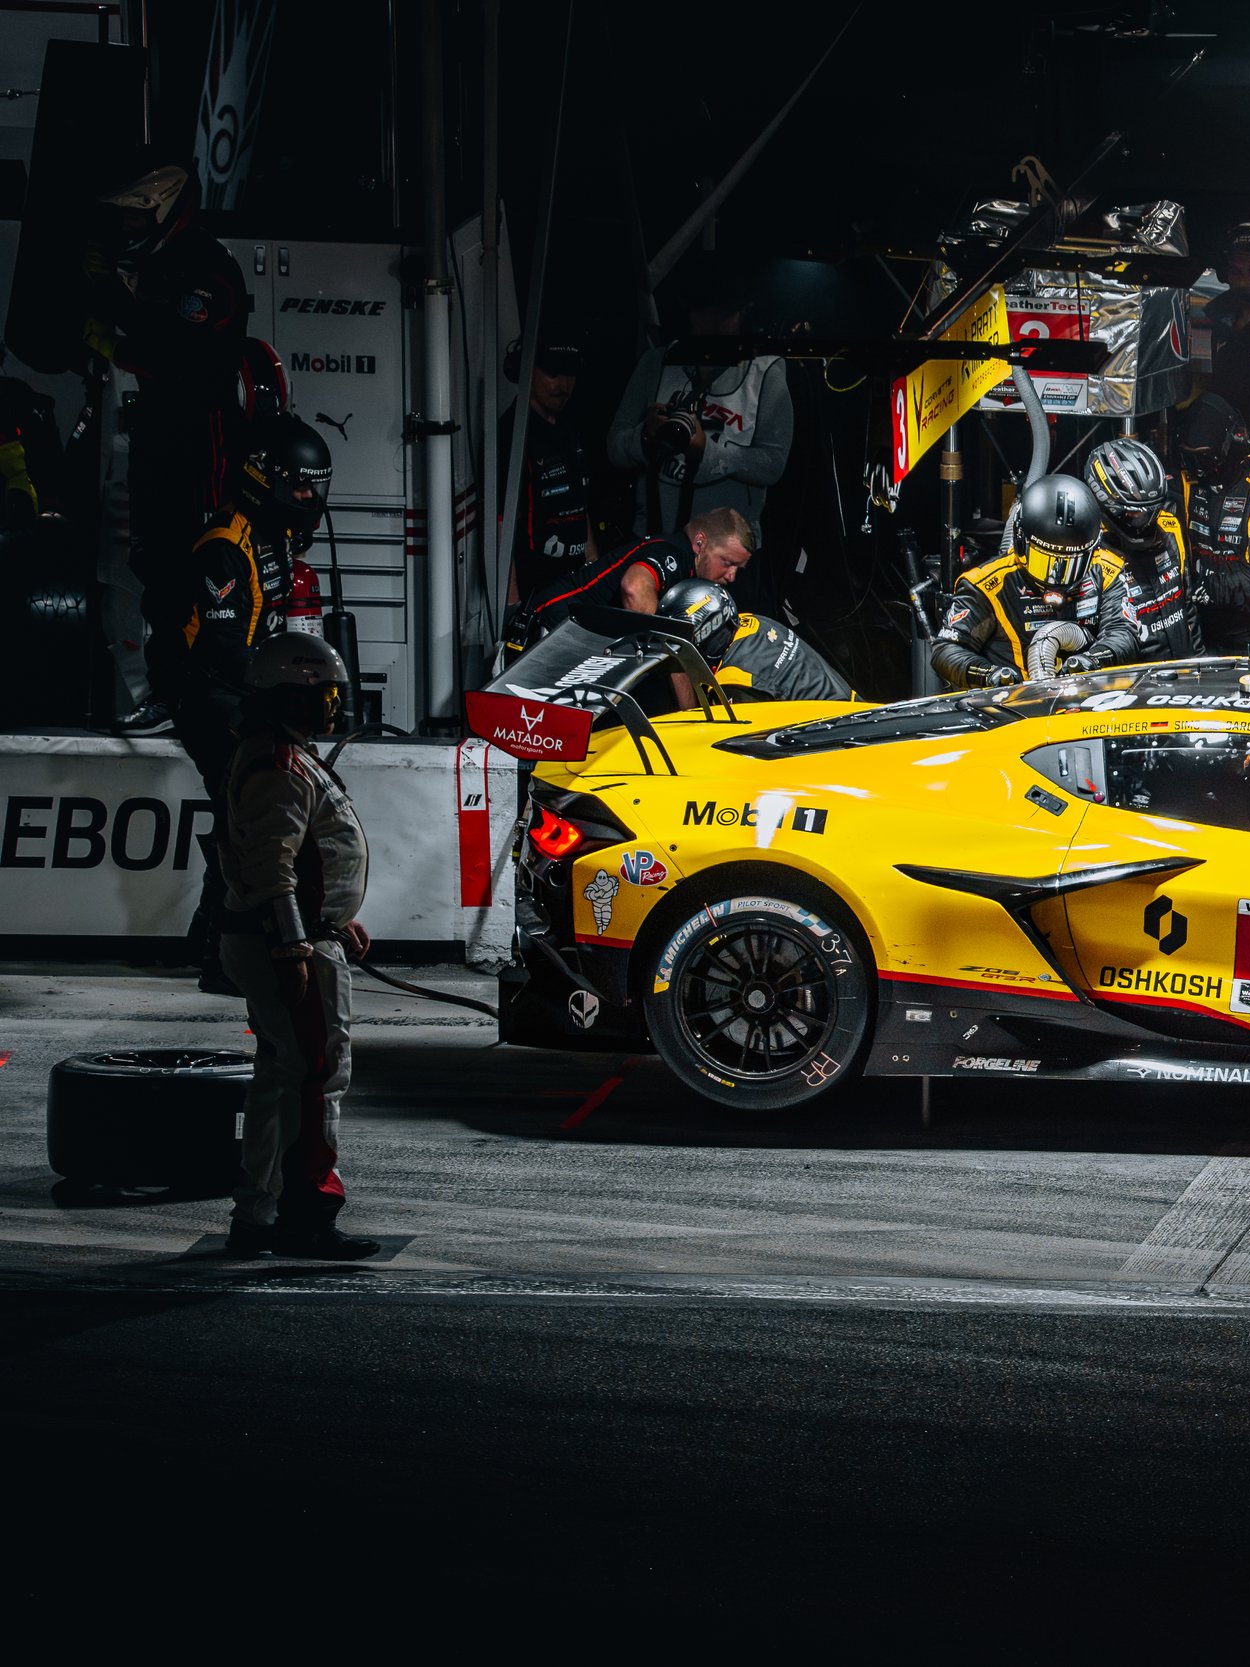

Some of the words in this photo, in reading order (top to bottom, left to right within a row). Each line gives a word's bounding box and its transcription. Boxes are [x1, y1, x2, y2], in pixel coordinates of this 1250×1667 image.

[280, 298, 386, 316] PENSKE
[1005, 300, 1086, 312] eatherTech
[291, 353, 351, 374] Mobil
[924, 376, 952, 409] CORVETTE
[701, 399, 743, 432] MSA
[921, 389, 955, 432] RACING
[896, 388, 907, 470] 3
[1162, 520, 1177, 528] OMP
[1030, 534, 1063, 552] PRATT
[1065, 539, 1095, 552] MILLER
[984, 577, 999, 590] OMP
[1150, 608, 1184, 633] OSHKOSH
[493, 726, 563, 752] MATADOR
[510, 743, 544, 755] motorsports
[683, 800, 784, 828] Mobl
[621, 850, 655, 886] VP
[642, 868, 668, 882] Racing
[736, 900, 761, 908] PILOT
[763, 900, 792, 912] SPORT
[663, 903, 725, 965] MICHELN
[1100, 966, 1223, 999] OSHKOSH
[952, 1055, 1042, 1072] FORGELINE
